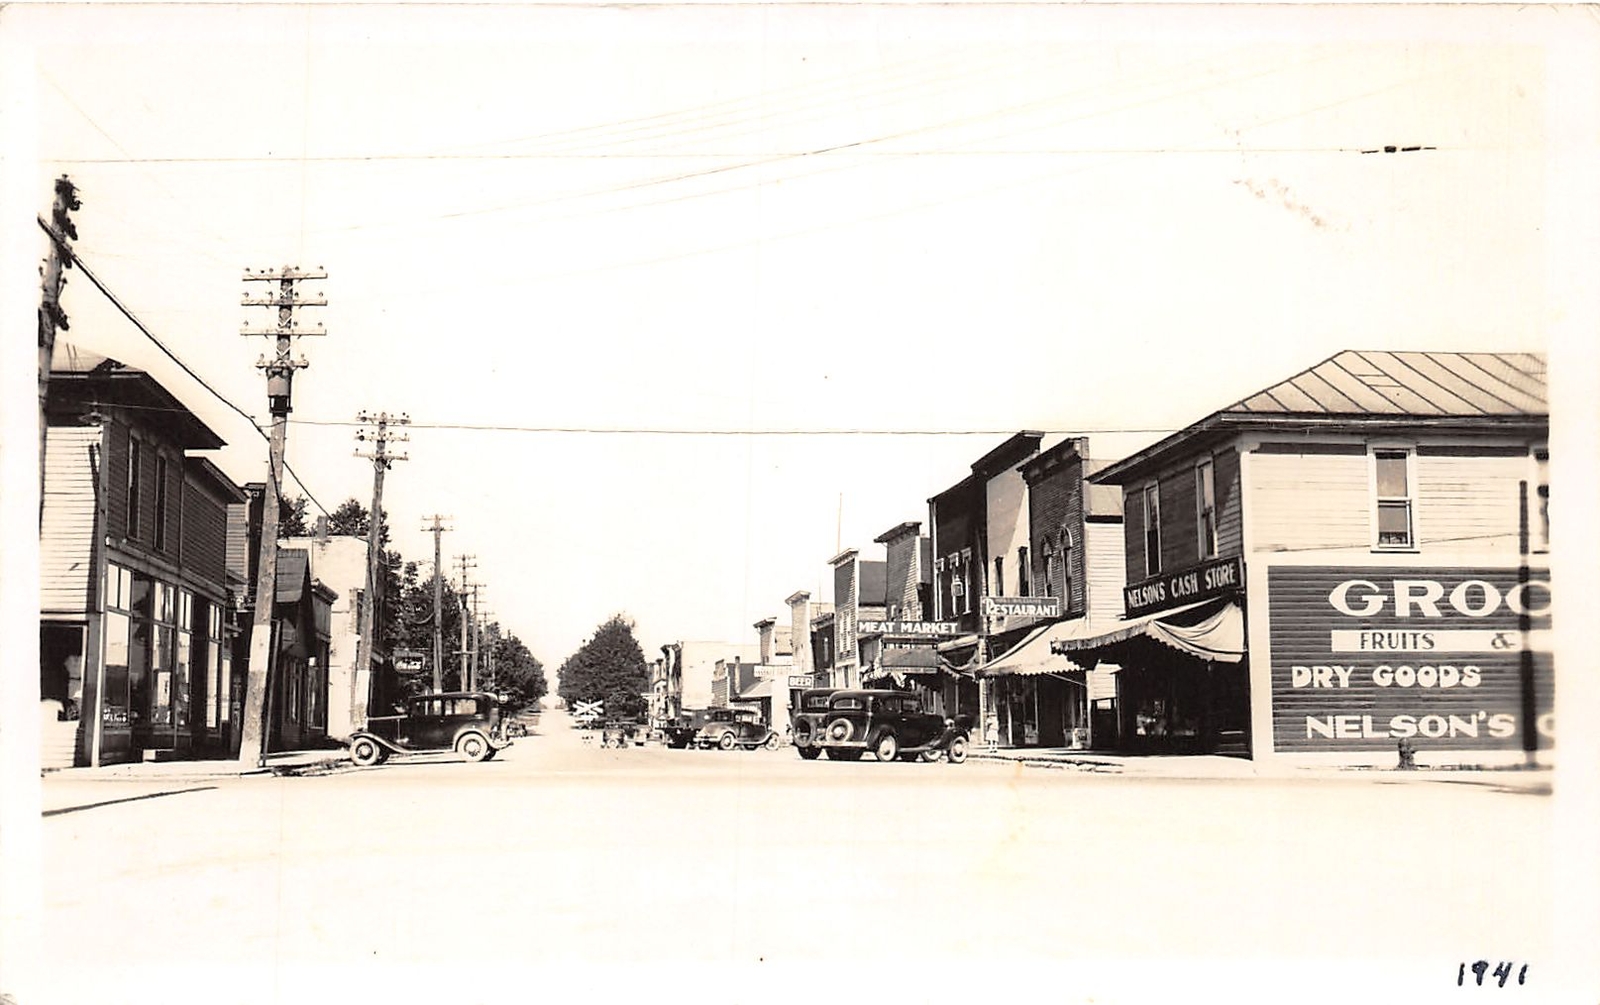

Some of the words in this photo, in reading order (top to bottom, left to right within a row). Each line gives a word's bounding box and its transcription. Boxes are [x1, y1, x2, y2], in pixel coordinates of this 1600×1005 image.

[1171, 573, 1198, 598] CASH
[1205, 563, 1236, 590] STORE
[985, 599, 1057, 615] RESTAURANT
[859, 622, 896, 633] MEAT
[901, 622, 958, 633] MARKET
[1360, 632, 1435, 649] FRUITS
[1491, 632, 1516, 649] &
[789, 676, 812, 686] BEER
[1292, 665, 1355, 688] DRY
[1372, 665, 1482, 687] GOODS
[1306, 711, 1515, 739] NELSON'S
[1457, 960, 1528, 988] 1941
